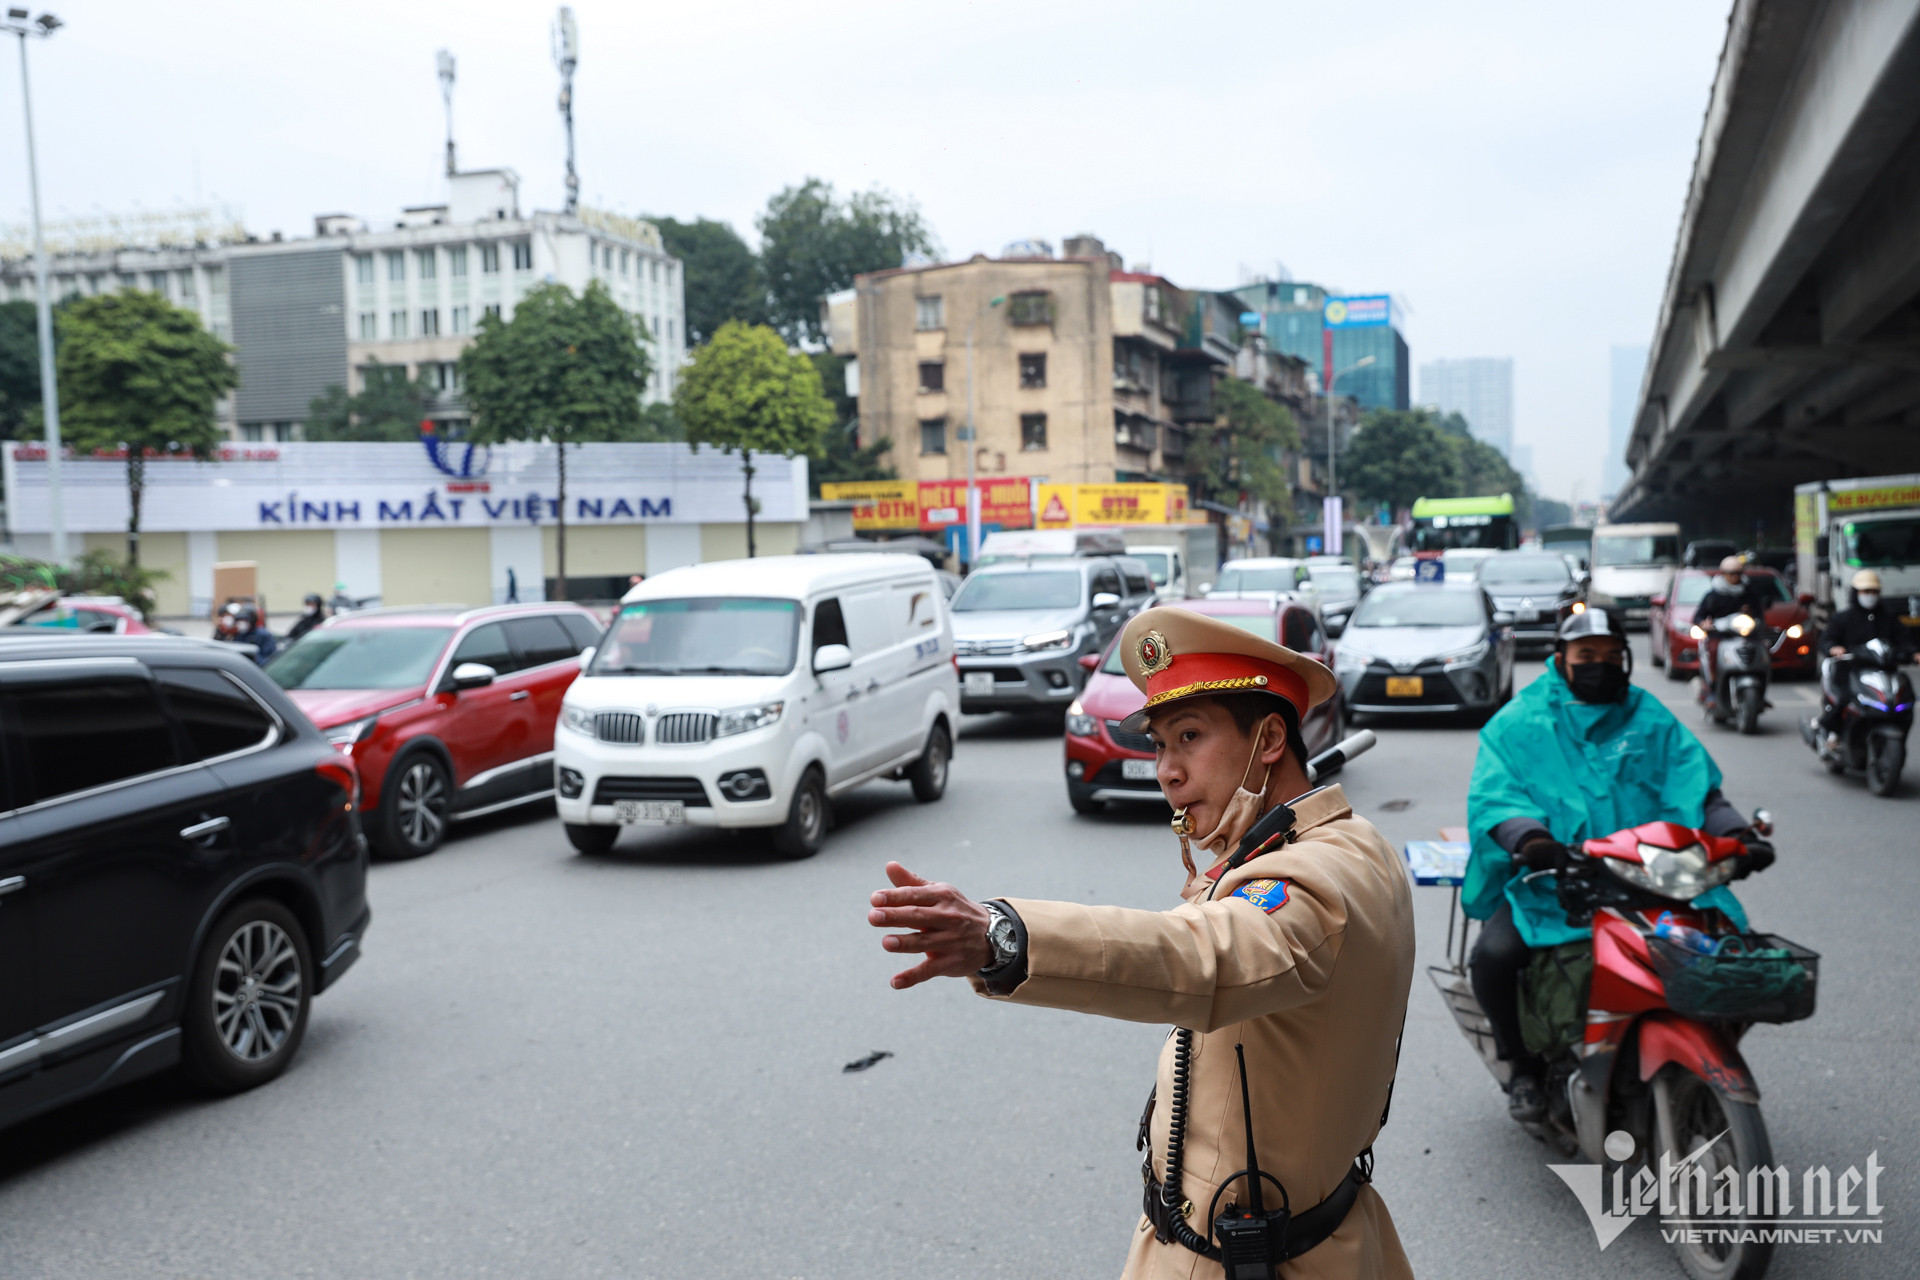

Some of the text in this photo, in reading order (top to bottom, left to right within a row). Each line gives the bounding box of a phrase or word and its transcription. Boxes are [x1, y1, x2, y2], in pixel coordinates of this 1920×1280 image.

[259, 487, 671, 525] KÍNH MẮT VIỆT NAM
